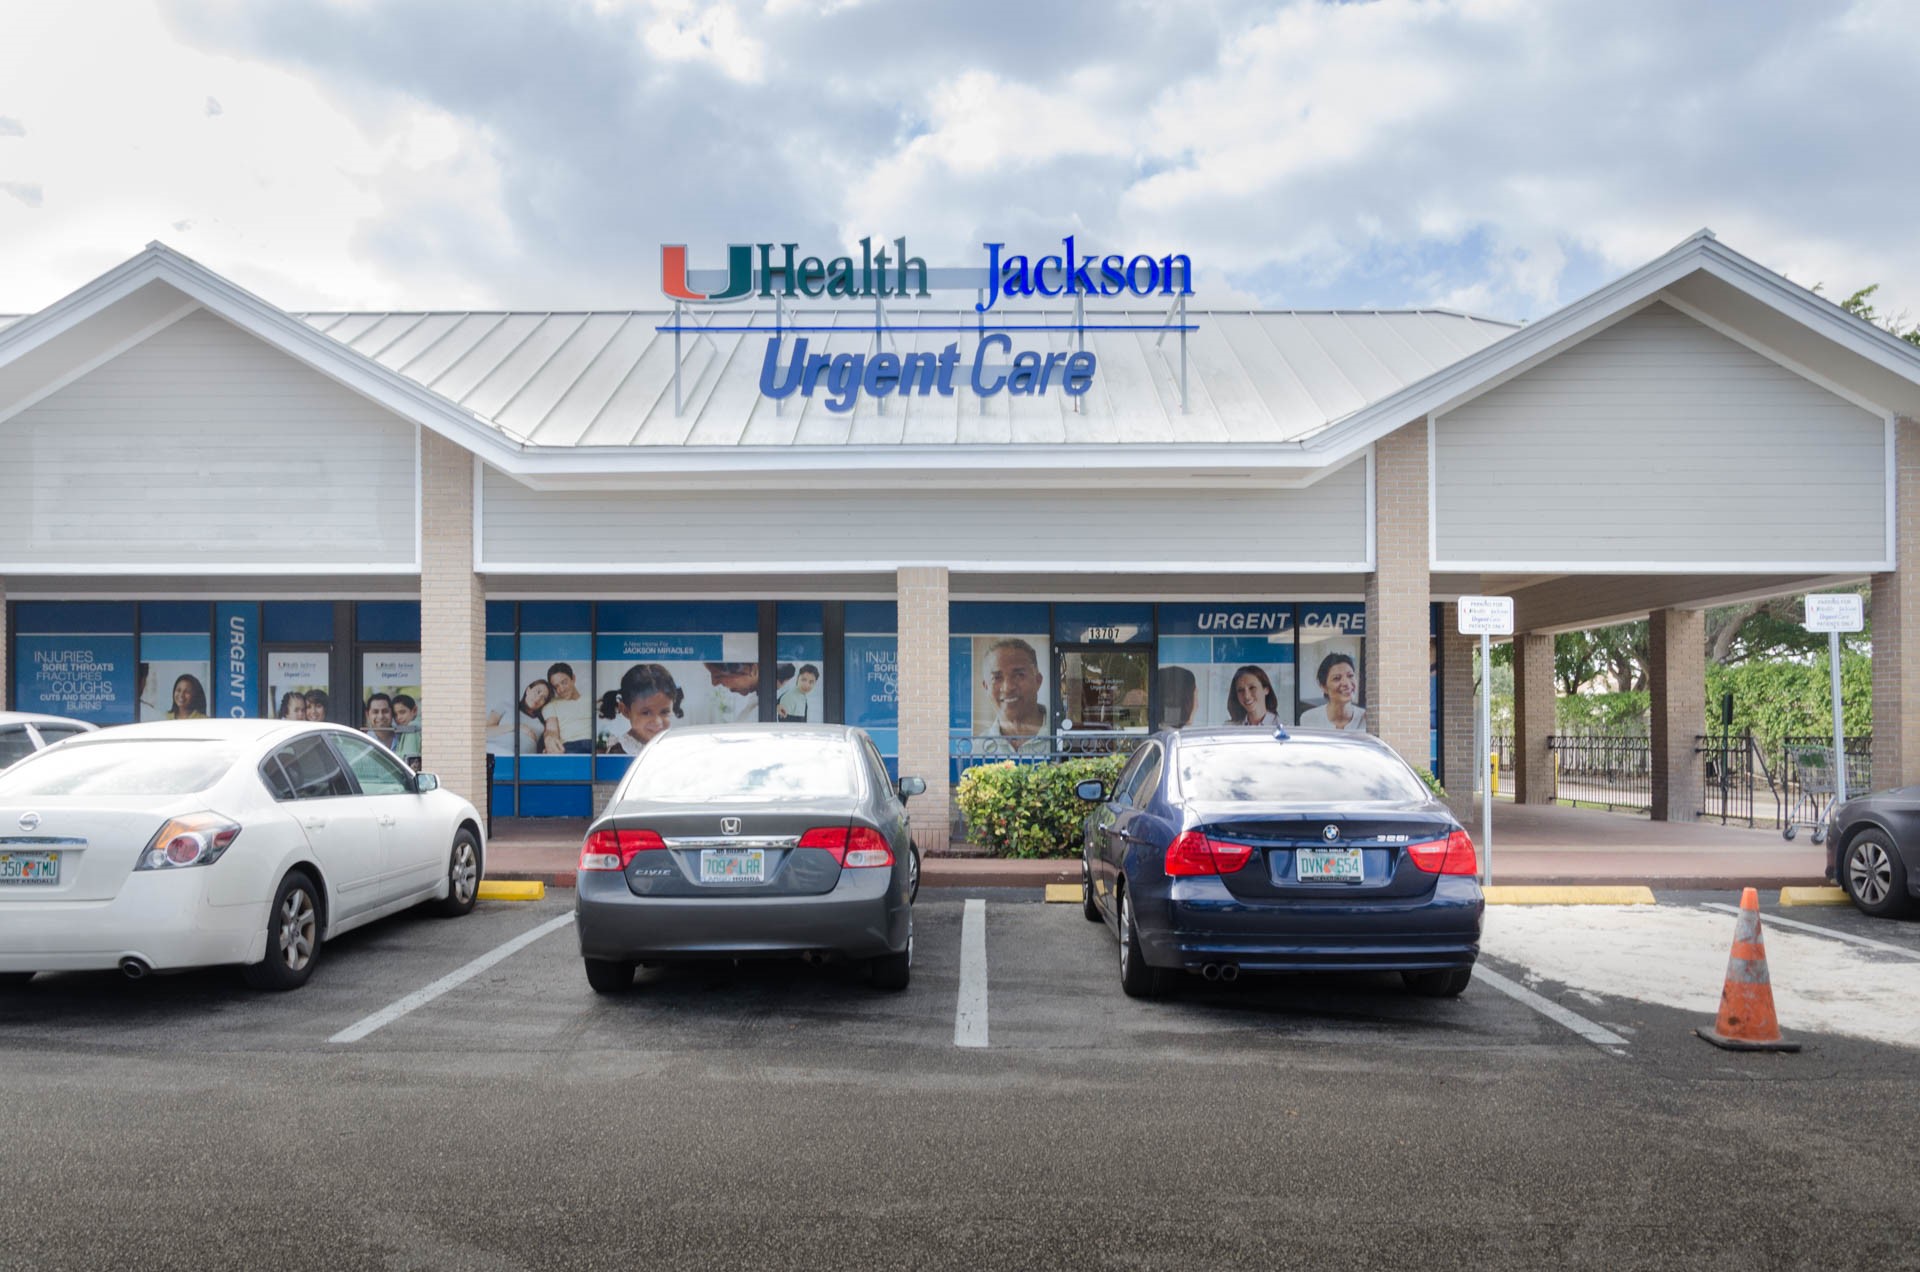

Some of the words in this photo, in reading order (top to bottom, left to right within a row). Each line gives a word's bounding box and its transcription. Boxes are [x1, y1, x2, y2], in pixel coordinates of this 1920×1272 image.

[975, 235, 1196, 312] Jackson
[759, 337, 961, 413] Urgent
[971, 333, 1096, 398] Care
[1198, 612, 1291, 630] URGENT
[1304, 612, 1366, 630] CARE
[1089, 628, 1120, 639] 13707
[34, 650, 94, 663] INJURIES
[230, 615, 245, 703] URGENT
[865, 650, 898, 664] INJU
[42, 663, 68, 672] SORE
[71, 663, 114, 672] THROATS
[36, 671, 102, 681] FRACTURES
[52, 681, 113, 694] COUGHS
[40, 693, 60, 701] CUTS
[62, 693, 79, 701] AND
[80, 693, 116, 701] SCRAPES
[871, 694, 893, 702] CUTS
[66, 701, 102, 711] BURNS
[0, 861, 21, 877] 350
[36, 861, 56, 877] TMU
[705, 859, 726, 875] 709
